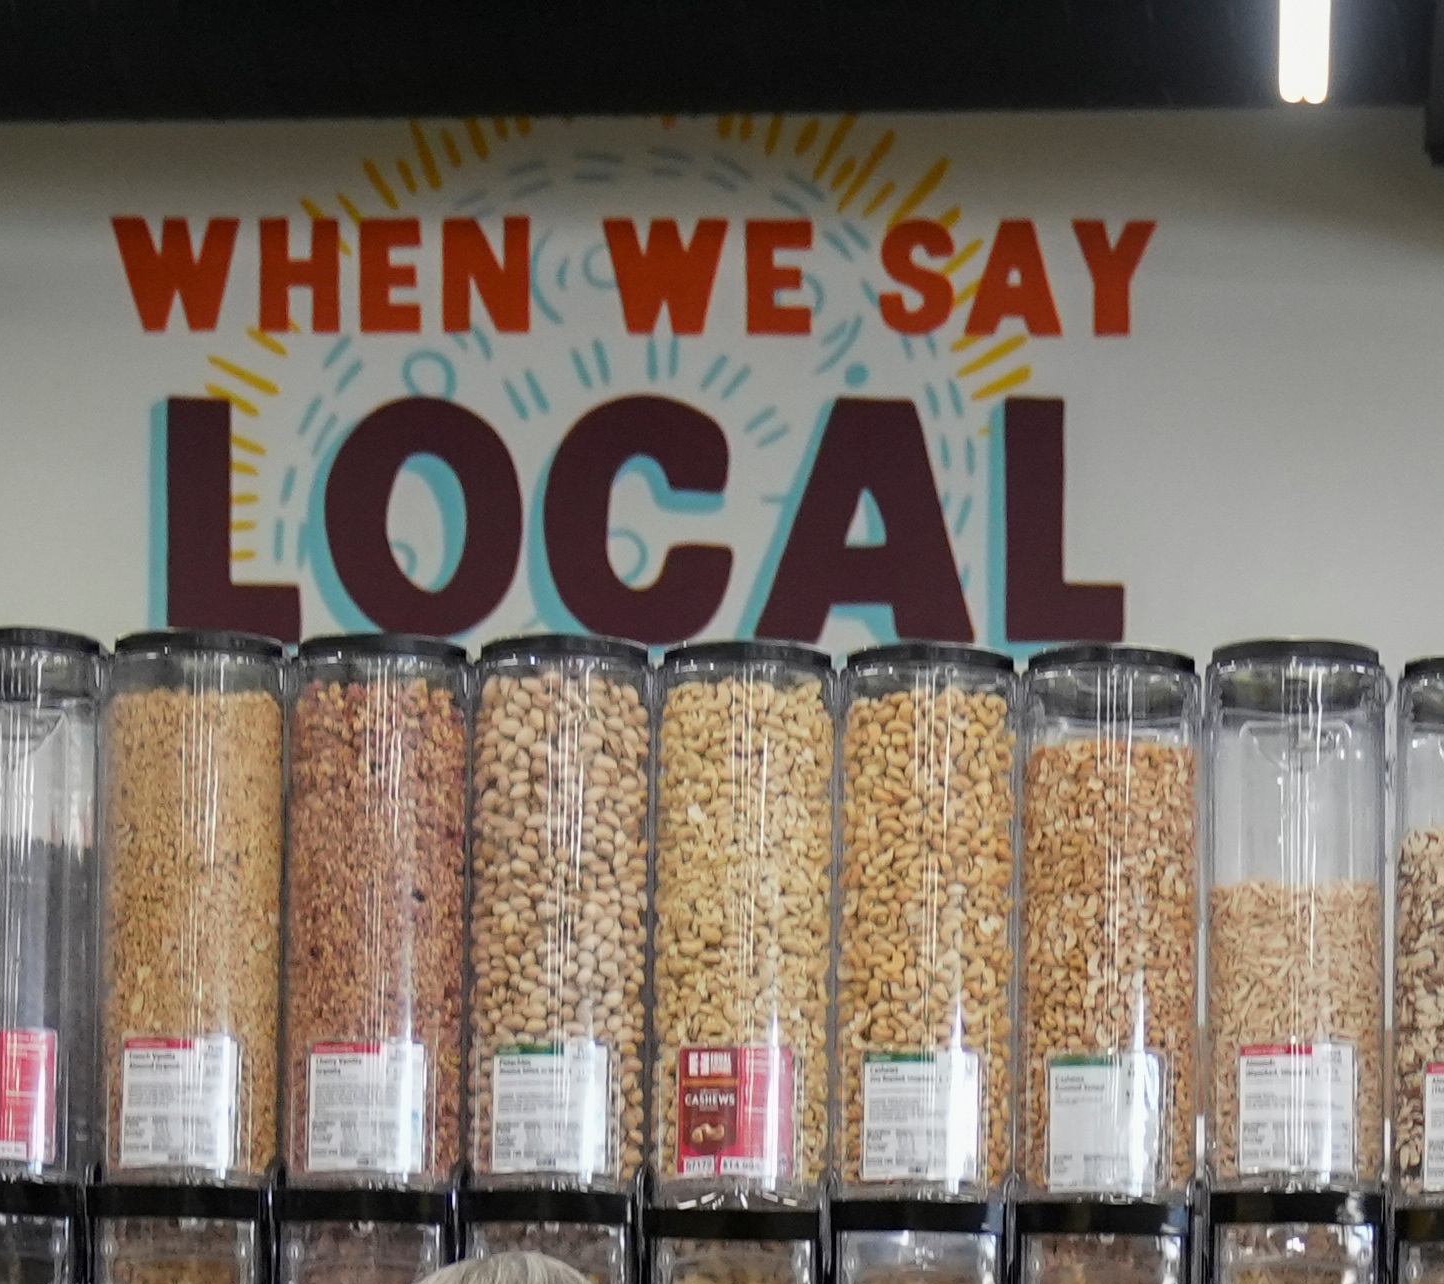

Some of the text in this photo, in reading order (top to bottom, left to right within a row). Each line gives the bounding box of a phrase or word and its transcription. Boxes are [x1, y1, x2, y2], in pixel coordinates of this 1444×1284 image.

[110, 216, 1154, 337] WHEN WE SAY
[161, 396, 1124, 645] LOCAL
[685, 1092, 735, 1107] CASHEWS
